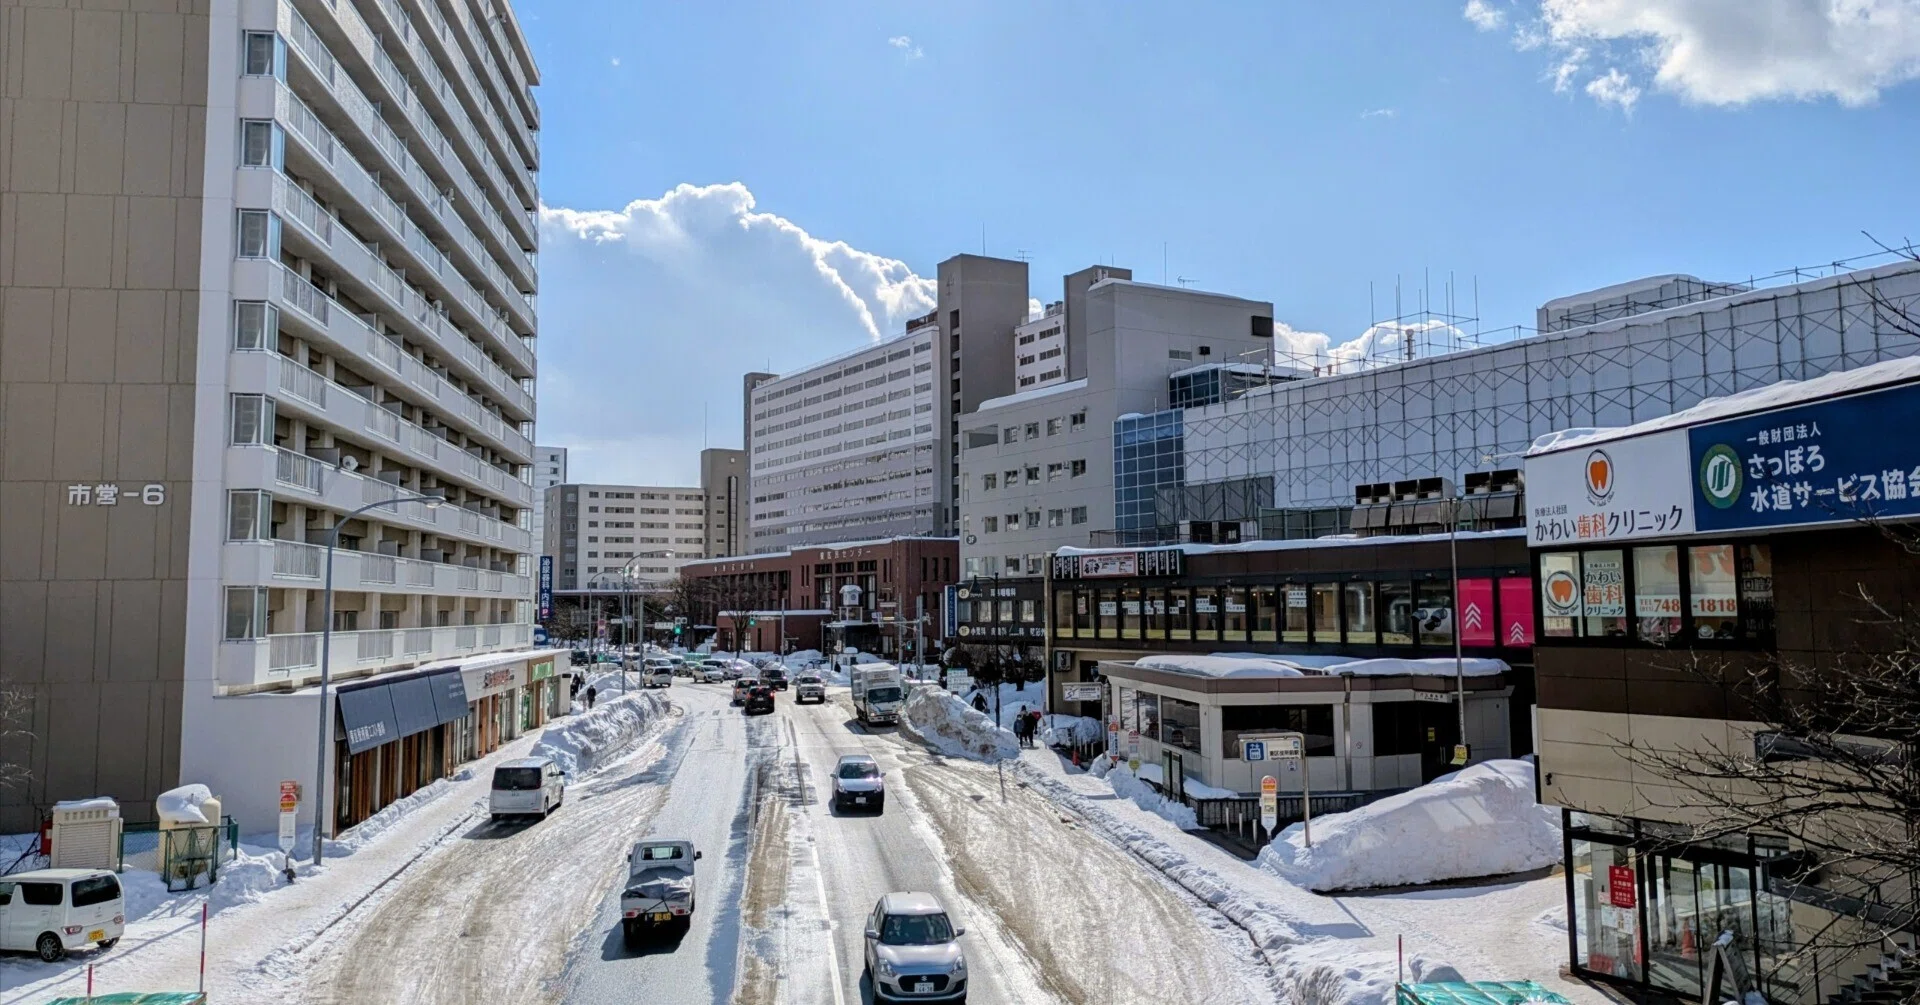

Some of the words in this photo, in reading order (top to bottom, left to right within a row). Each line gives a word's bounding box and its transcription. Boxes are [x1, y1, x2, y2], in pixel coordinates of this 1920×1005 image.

[1746, 421, 1822, 446] 一般財団法人
[1748, 445, 1825, 479] さっぽろ
[1535, 505, 1683, 541] かわい歯科クリニック
[541, 558, 551, 608] 泌尿器科・内科
[1585, 571, 1622, 583] かわい
[1586, 584, 1623, 605] 歯科
[1654, 599, 1680, 613] 748
[1586, 606, 1624, 616] クリニック
